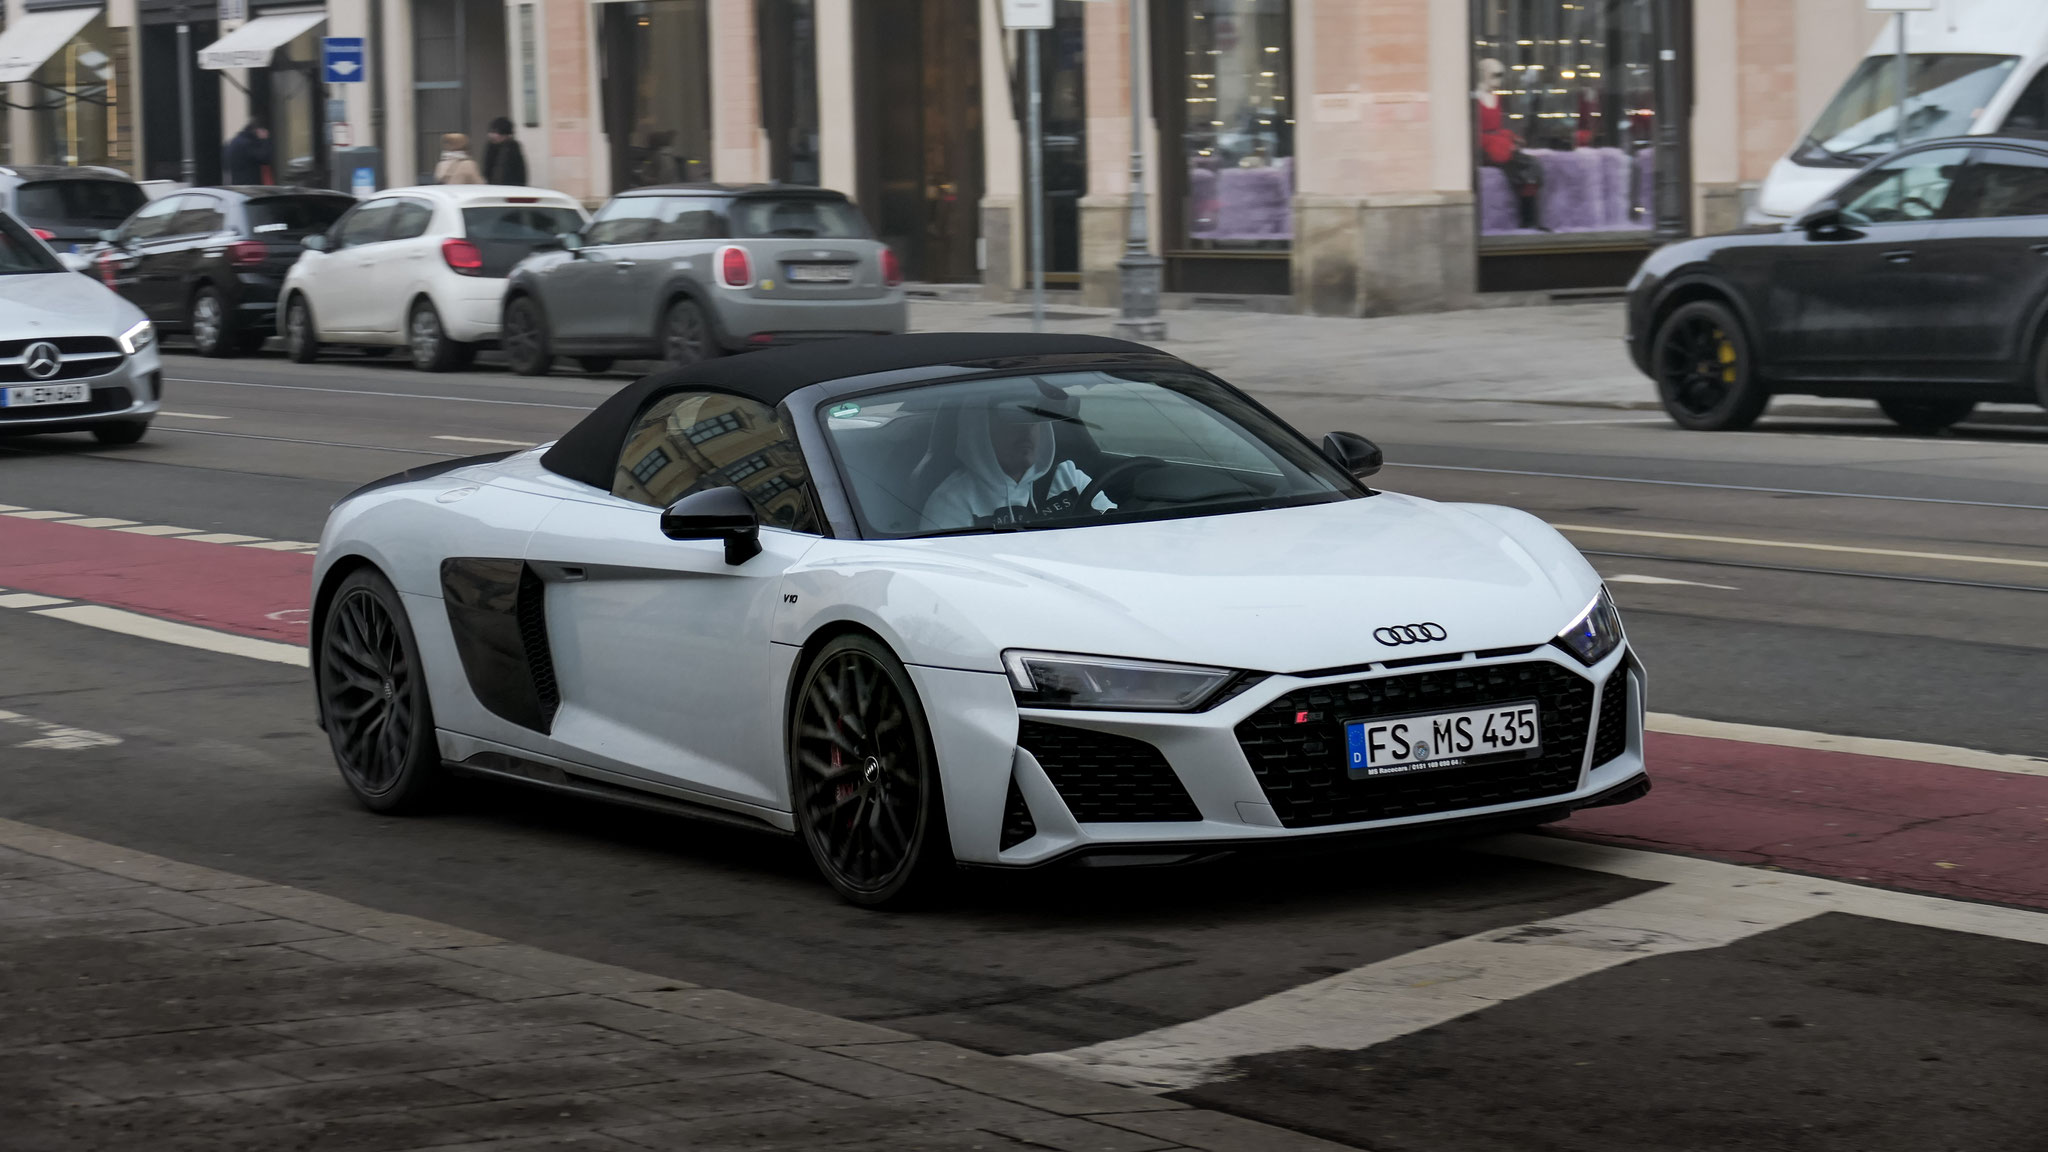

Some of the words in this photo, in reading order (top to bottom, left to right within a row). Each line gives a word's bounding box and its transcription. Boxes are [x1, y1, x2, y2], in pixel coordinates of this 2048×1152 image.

[784, 594, 798, 603] V10
[1368, 724, 1410, 763] FS
[1433, 717, 1473, 754] MS
[1482, 709, 1535, 748] 435
[1354, 752, 1362, 763] D
[1379, 766, 1408, 774] Racecars
